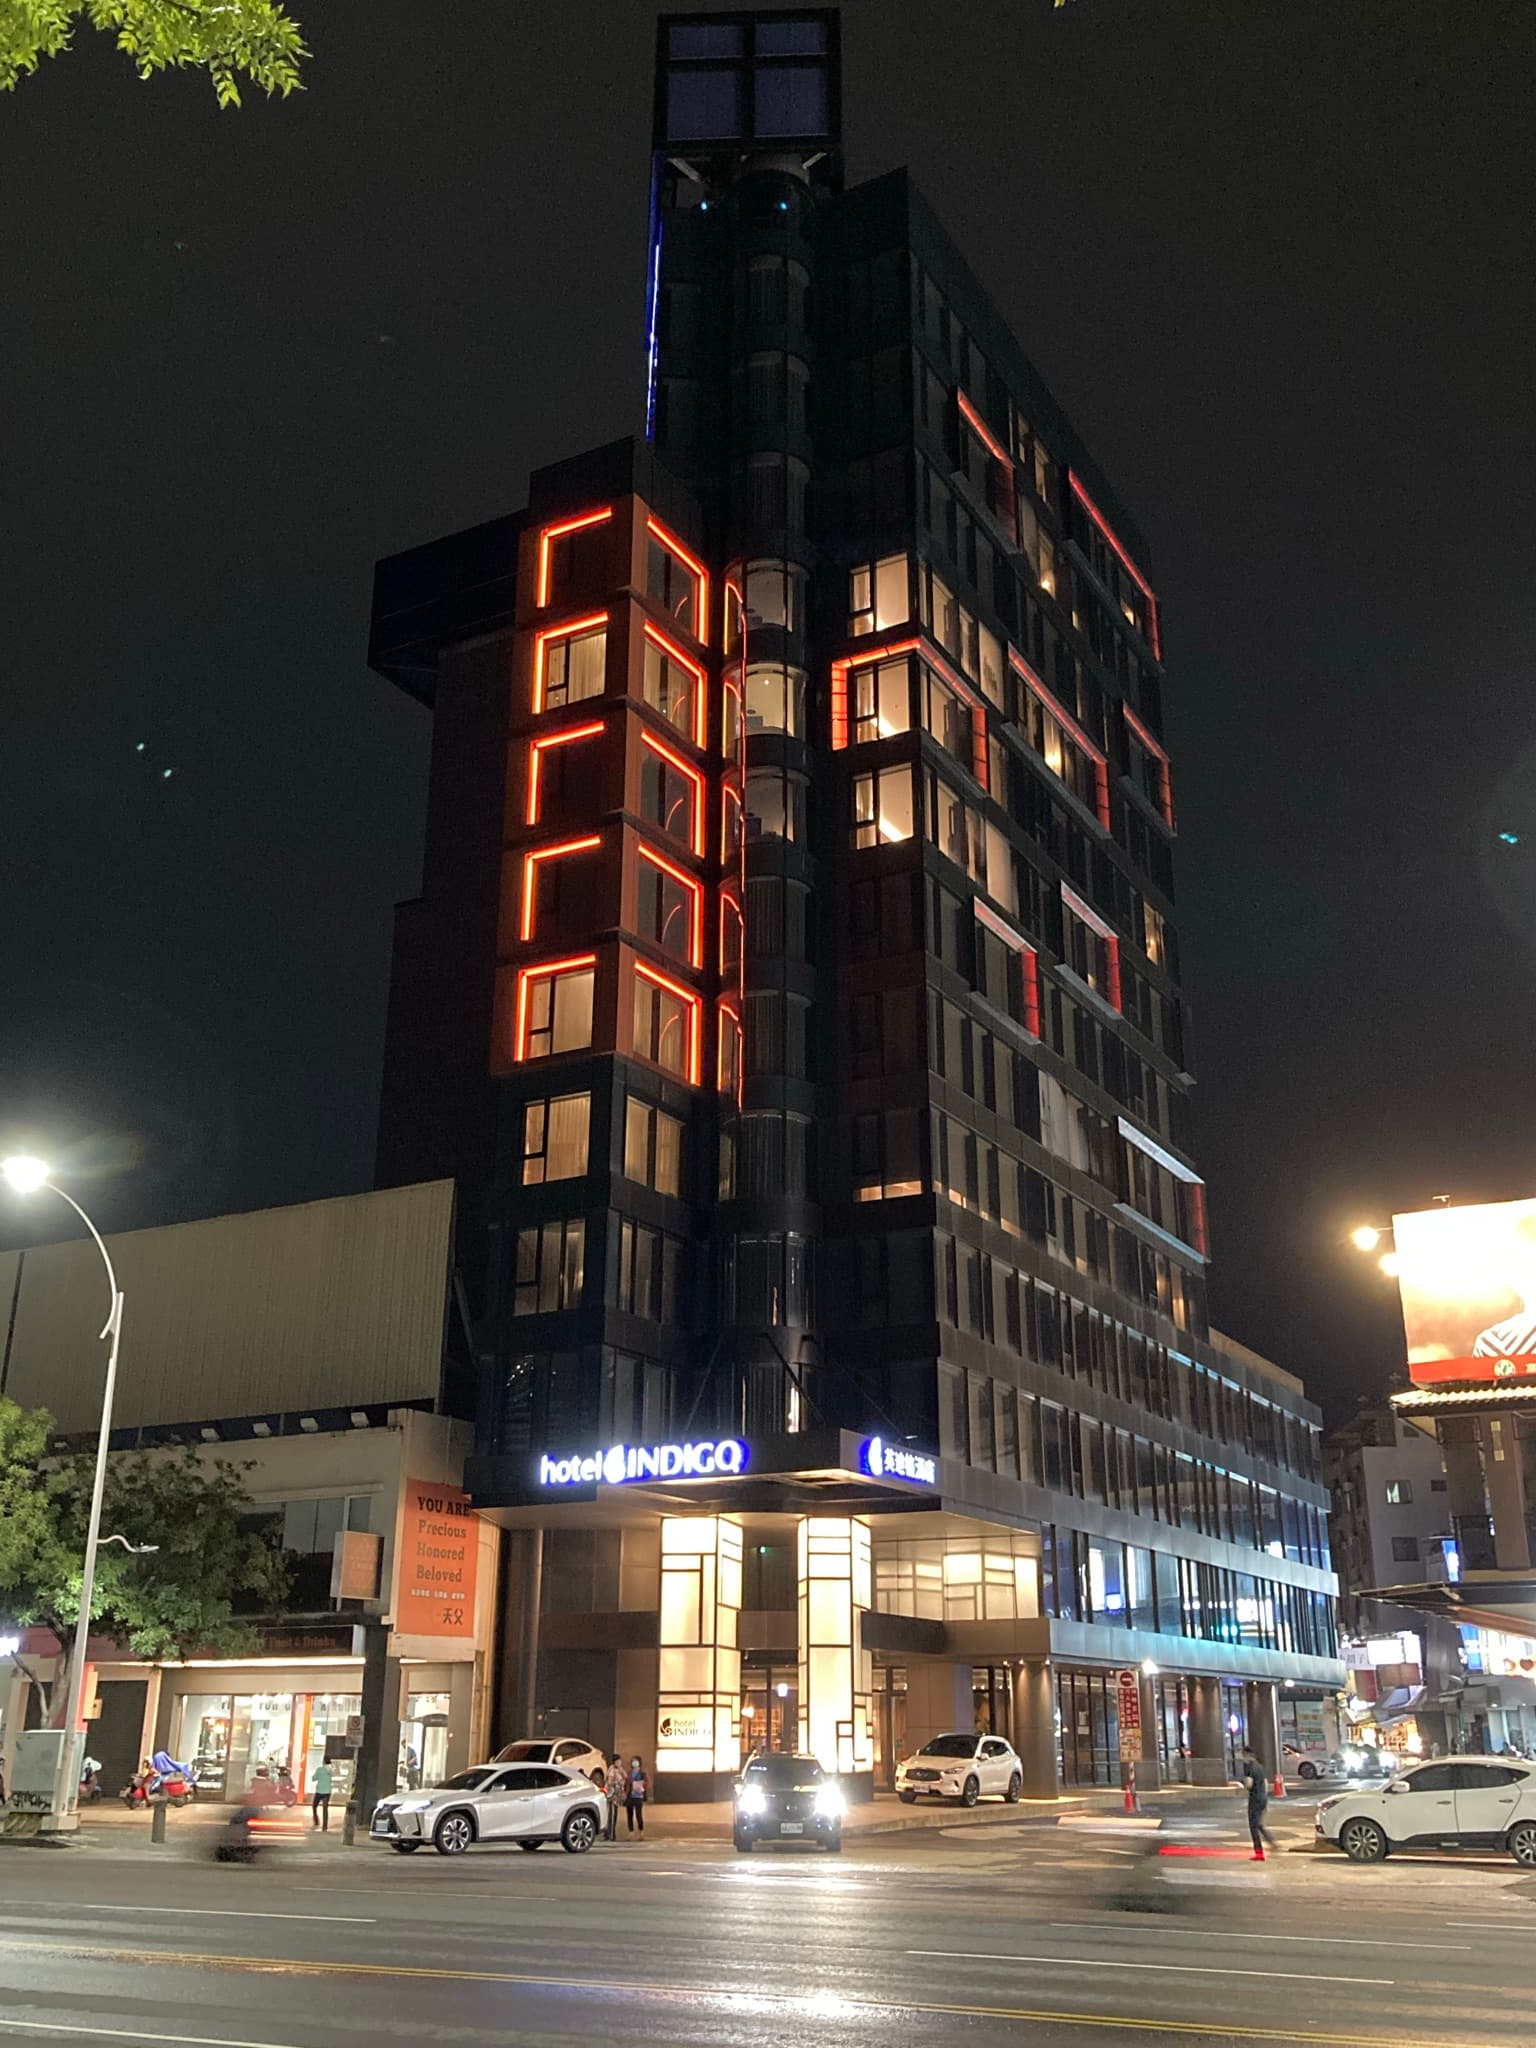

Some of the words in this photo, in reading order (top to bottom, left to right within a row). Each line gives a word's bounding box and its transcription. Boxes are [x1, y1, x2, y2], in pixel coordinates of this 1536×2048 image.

[540, 1449, 603, 1484] hotel
[417, 1496, 443, 1514] YOU
[446, 1501, 472, 1517] ARE
[418, 1519, 467, 1538] Precious
[416, 1541, 465, 1561] Honored
[416, 1563, 462, 1582] Beloved
[443, 1607, 464, 1625] 天父
[673, 1719, 696, 1728] hotel
